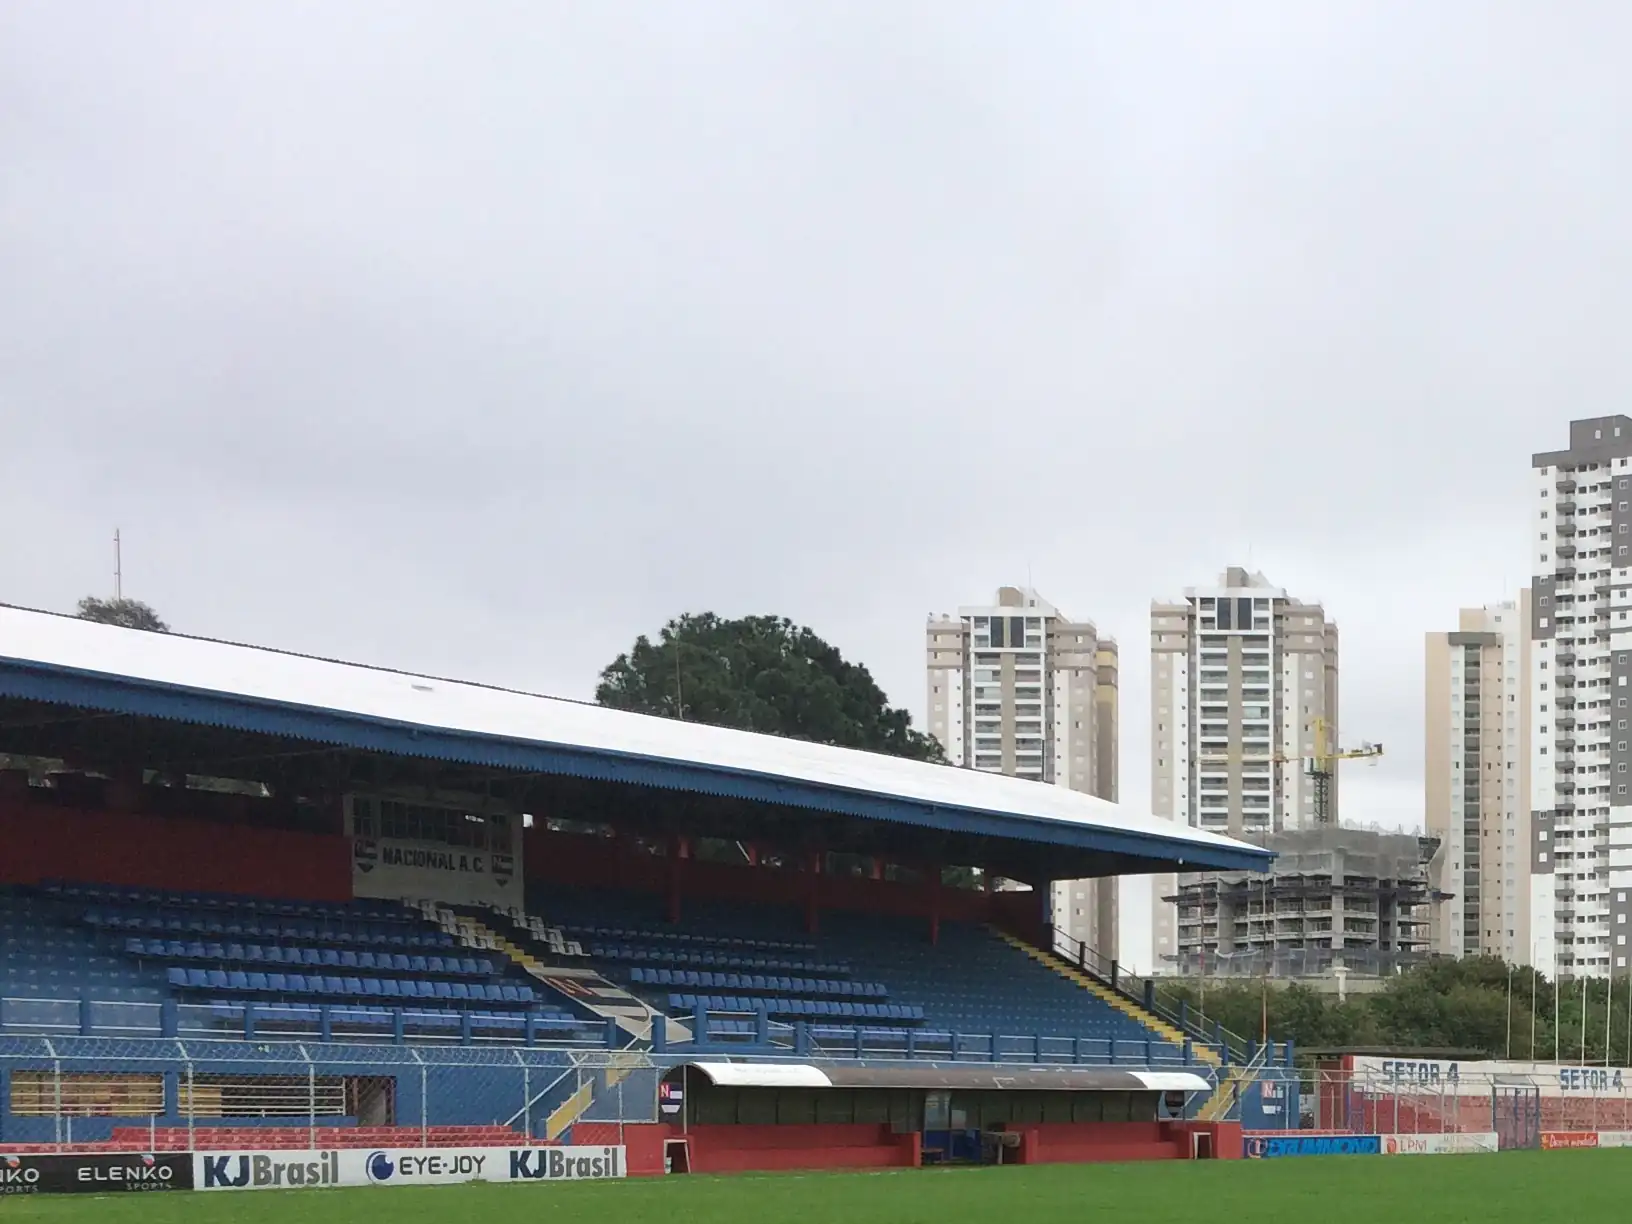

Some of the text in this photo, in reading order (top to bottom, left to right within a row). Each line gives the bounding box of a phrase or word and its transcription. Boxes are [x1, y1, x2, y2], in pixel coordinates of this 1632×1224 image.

[383, 847, 456, 871] NACIONAL
[1382, 1061, 1460, 1086] SETOR 4
[1560, 1068, 1622, 1092] SETOR 4
[78, 1166, 172, 1181] ELENKO
[203, 1151, 338, 1188] KJBrasil
[509, 1148, 618, 1179] KJBrasil
[126, 1183, 172, 1191] SPORTS
